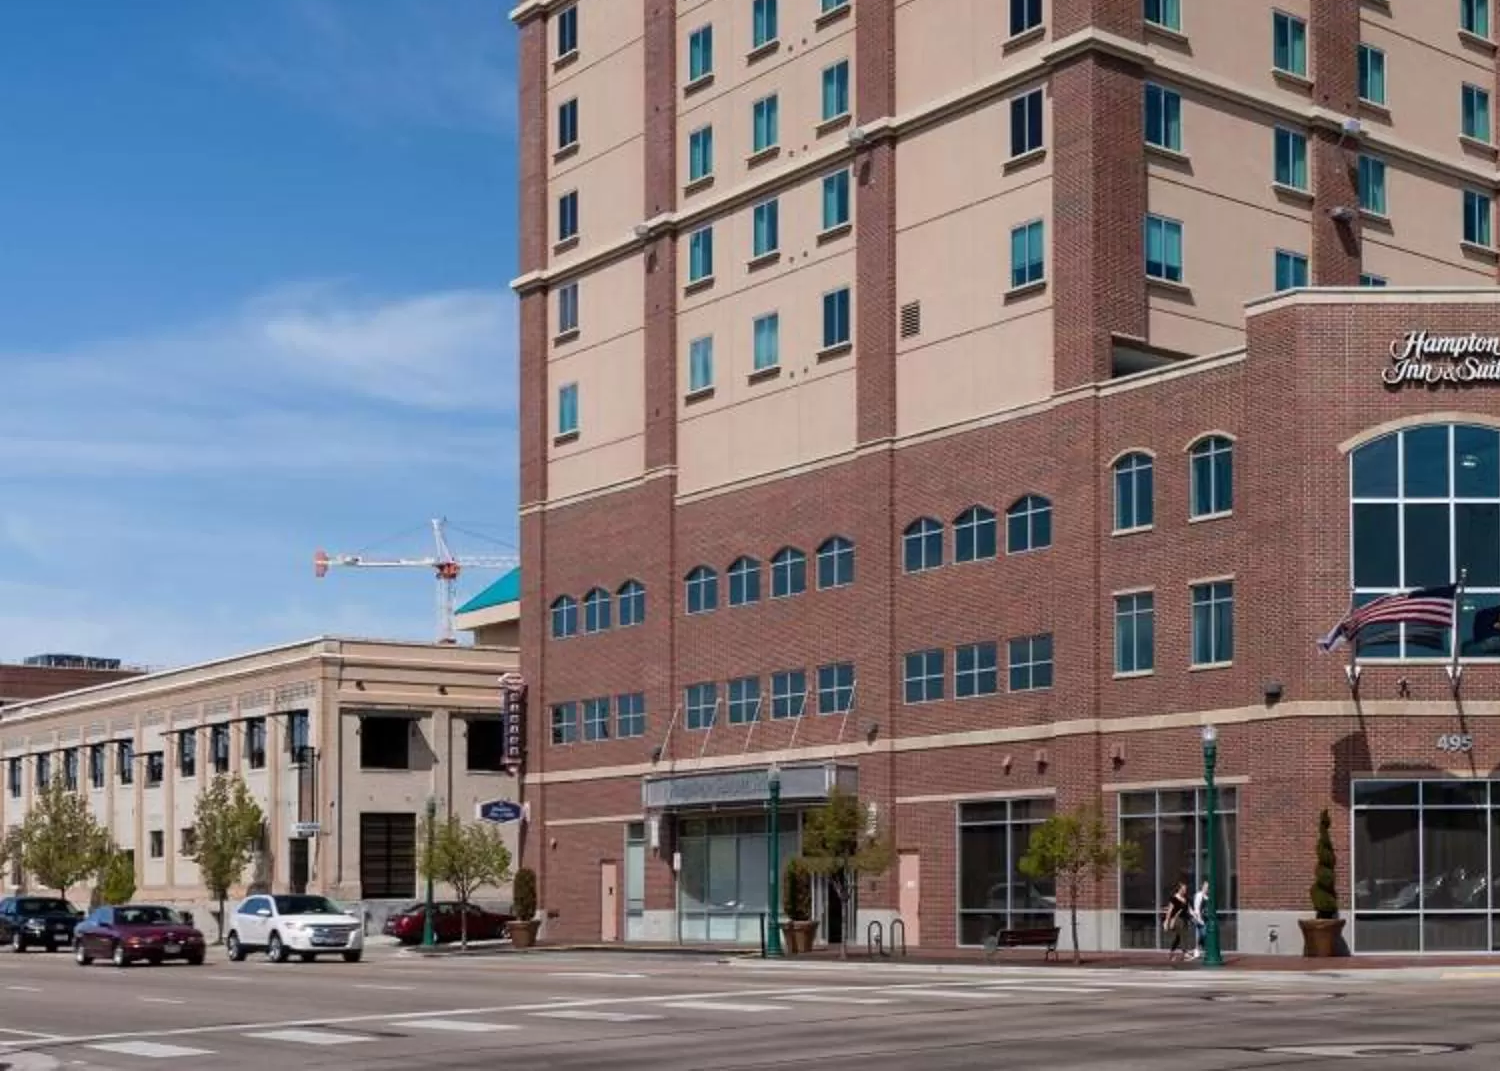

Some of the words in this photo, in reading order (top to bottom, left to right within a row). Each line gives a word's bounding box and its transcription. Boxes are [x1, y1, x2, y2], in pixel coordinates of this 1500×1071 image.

[1381, 359, 1443, 384] Inn
[1443, 364, 1459, 382] &
[1436, 734, 1473, 751] 495
